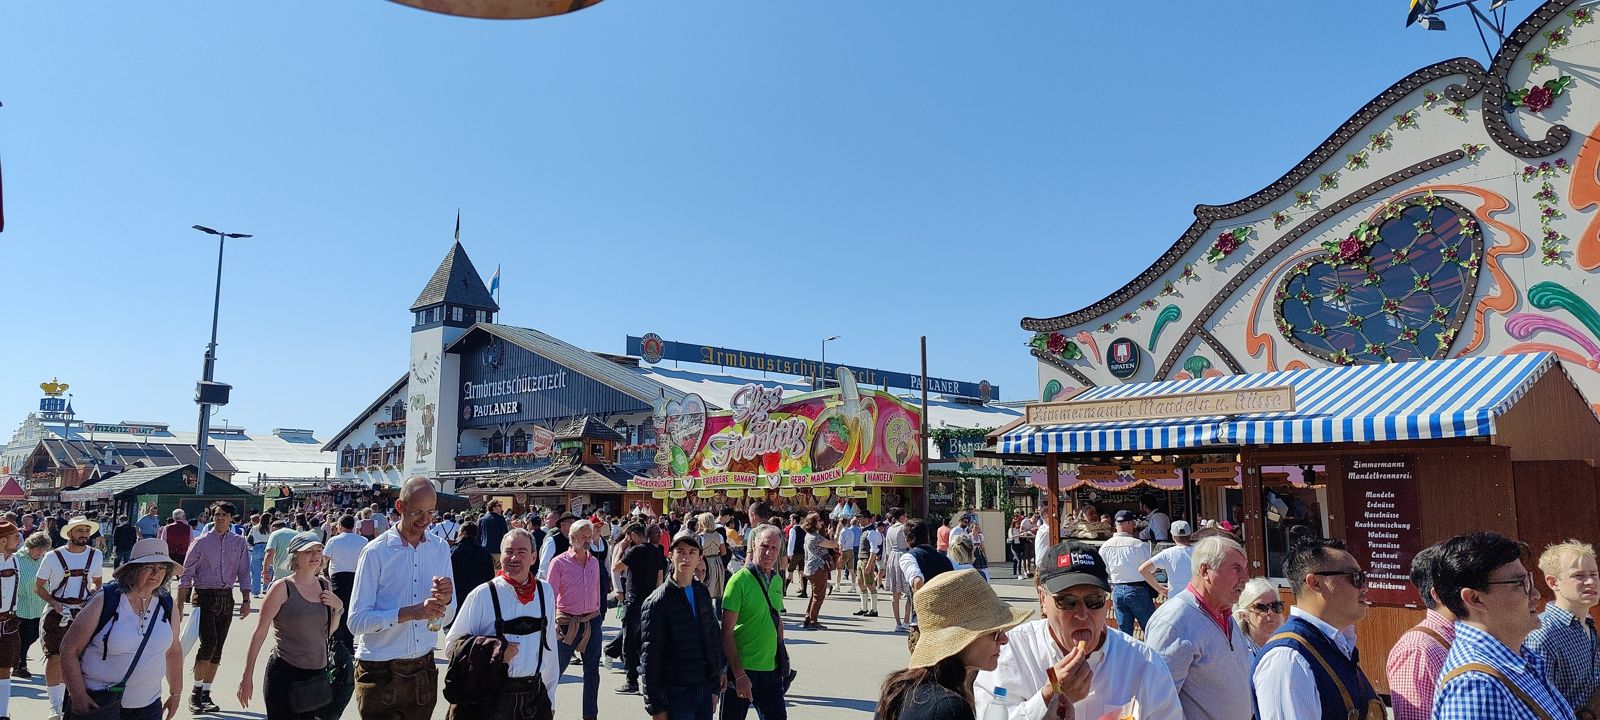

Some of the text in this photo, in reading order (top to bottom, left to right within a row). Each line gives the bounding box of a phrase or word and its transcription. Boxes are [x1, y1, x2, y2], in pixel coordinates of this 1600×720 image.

[700, 346, 876, 384] Armbrustschützzelt
[910, 375, 960, 394] PALANER
[464, 369, 567, 400] Armbrustschützenzelt
[1139, 395, 1209, 416] Mandeln
[1235, 391, 1281, 410] Nüsse
[473, 401, 518, 417] PAULANER
[1352, 460, 1405, 468] Zimmermanns
[811, 469, 840, 482] MANDELN
[1364, 511, 1399, 519] Haselnüsse
[1354, 521, 1411, 530] Knabbermischung
[1368, 531, 1399, 539] Walnüsse
[1368, 541, 1400, 549] Paranüsse
[1371, 551, 1398, 559] Cashews
[1370, 561, 1401, 569] Pistazien
[1368, 581, 1406, 590] Kürbiskerne
